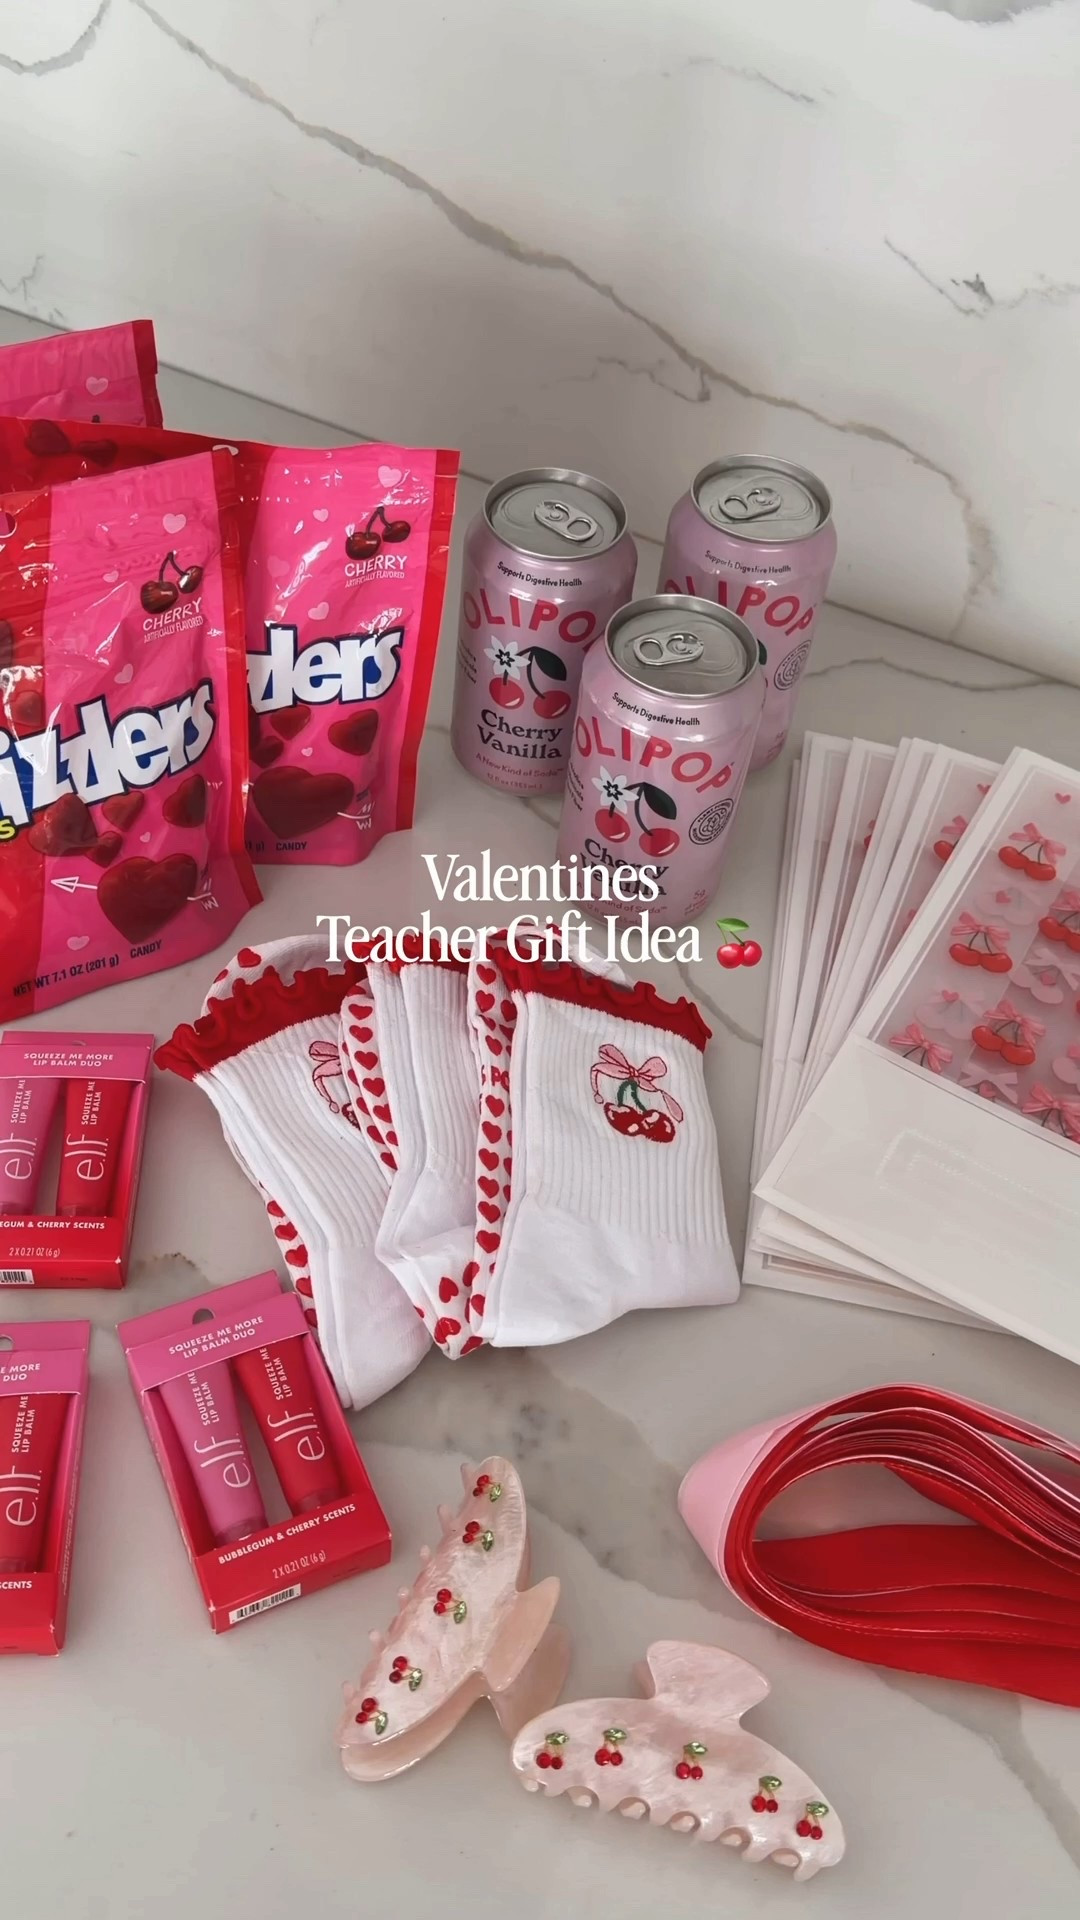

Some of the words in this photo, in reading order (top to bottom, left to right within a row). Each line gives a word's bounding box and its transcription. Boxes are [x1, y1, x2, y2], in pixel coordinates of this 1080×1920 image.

[344, 555, 408, 577] CHERRY
[497, 561, 524, 580] Supports
[526, 574, 558, 586] Digestive
[559, 578, 582, 586] Health
[704, 550, 733, 568] Supports
[734, 562, 768, 574] Digestive
[768, 565, 792, 574] Health
[344, 573, 376, 588] ARTIFICIALLY
[376, 570, 404, 580] FLAVORED
[142, 597, 202, 631] CHERRY
[464, 588, 604, 652] OLIPO
[144, 625, 176, 643] ARTIFICIALLY
[176, 616, 204, 632] FLAVORED
[612, 692, 639, 714] Supports
[640, 708, 674, 725] Digestive
[675, 717, 700, 726] Health
[481, 709, 563, 742] Cherry
[477, 724, 562, 759] Vanilla
[576, 716, 732, 793] OLIPOP
[276, 841, 307, 851] CANDY
[13, 981, 32, 997] NET
[34, 975, 51, 988] WT
[53, 966, 68, 983] 7.1
[69, 964, 84, 978] OZ
[86, 958, 108, 974] (201
[110, 954, 120, 968] g)
[130, 940, 162, 959] CANDY
[24, 1052, 66, 1060] SQUEEZE
[10, 1091, 23, 1123] SQUEEZE
[22, 1090, 32, 1110] BALM
[82, 1092, 93, 1124] SQUEEZE
[92, 1092, 102, 1112] BALM
[90, 1114, 98, 1124] LIP
[73, 1222, 105, 1230] SCENTS
[9, 1248, 14, 1256] 2
[20, 1247, 34, 1256] 0.21
[36, 1248, 44, 1257] OZ
[168, 1333, 214, 1354] SQUEEZE
[216, 1327, 231, 1338] ME
[234, 1316, 264, 1332] MORE
[184, 1349, 198, 1358] LIP
[202, 1338, 230, 1352] BALM
[233, 1328, 256, 1340] DUO
[260, 1348, 270, 1360] ME
[3, 1374, 28, 1382] DUO
[10, 1364, 40, 1373] MORE
[188, 1372, 198, 1384] ME
[274, 1358, 288, 1382] BALM
[265, 1362, 284, 1400] SQUEEZE
[282, 1385, 292, 1398] LIP
[201, 1382, 214, 1406] BALM
[192, 1387, 210, 1426] SQUEEZE
[210, 1410, 220, 1423] LIP
[12, 1410, 26, 1452] SQUEEZE
[20, 1396, 28, 1408] ME
[25, 1410, 36, 1435] BALM
[22, 1439, 30, 1452] LIP
[218, 1536, 274, 1564] BUBBLEGUM
[276, 1532, 284, 1541] &
[286, 1517, 320, 1536] CHERRY
[323, 1504, 356, 1522] SCENTS
[272, 1568, 278, 1579] 2
[285, 1560, 300, 1574] 0.21
[300, 1556, 309, 1568] OZ
[310, 1552, 318, 1565] (6
[318, 1550, 326, 1562] g)
[0, 1580, 32, 1590] CENTS
